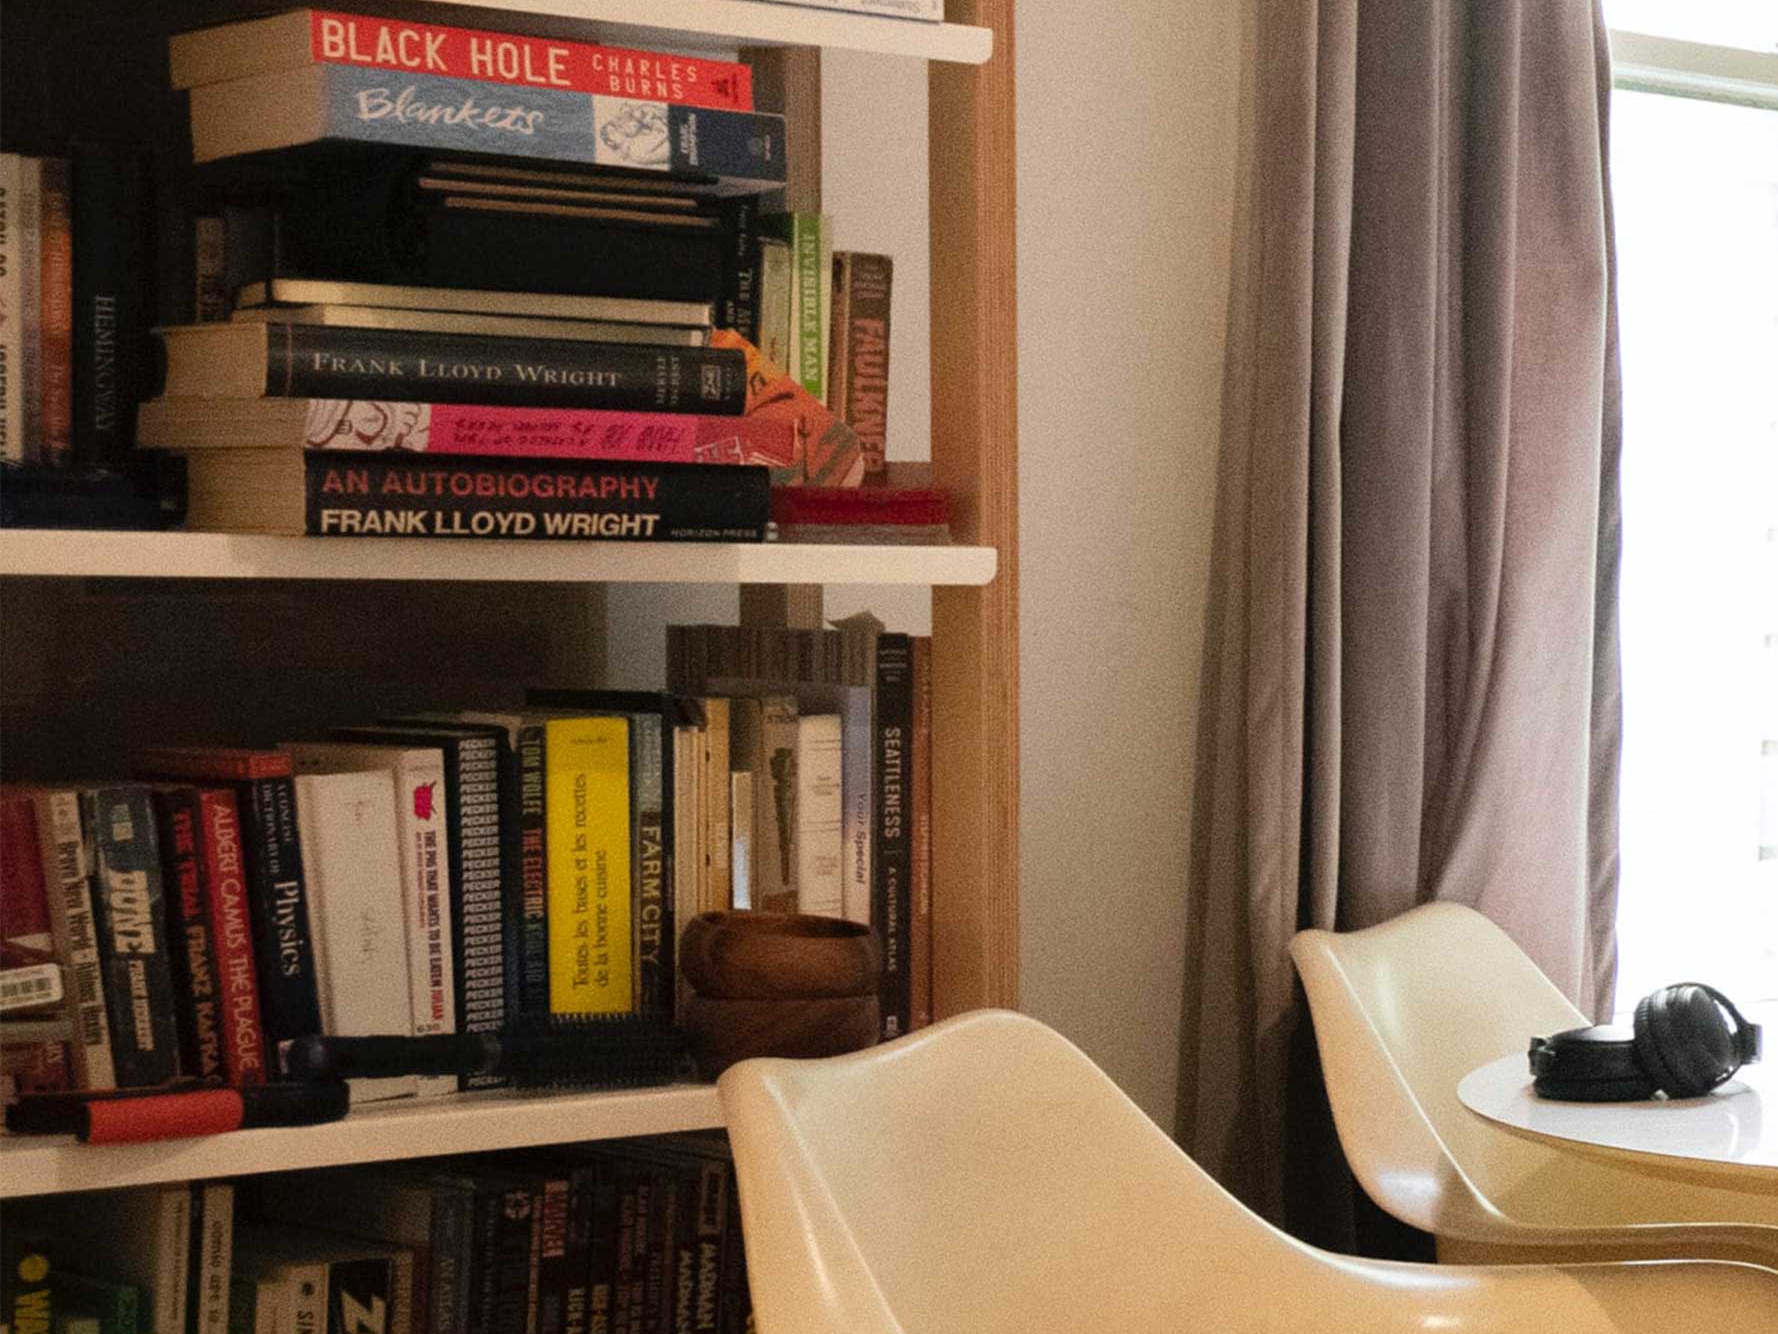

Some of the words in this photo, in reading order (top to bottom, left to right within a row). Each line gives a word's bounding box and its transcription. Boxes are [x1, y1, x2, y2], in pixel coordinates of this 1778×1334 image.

[322, 19, 448, 72] BLACK
[471, 38, 571, 86] HOLE
[591, 53, 698, 83] CHARLES
[357, 85, 545, 135] Blankets
[609, 75, 684, 101] BURNS
[801, 233, 817, 334] INVISIBLE
[94, 295, 116, 432] HEMINGWAY
[312, 352, 403, 375] FRANK
[418, 358, 514, 381] LLOYD
[515, 364, 621, 387] WRIGHT
[803, 337, 819, 381] MAN
[322, 469, 368, 495] AN
[382, 471, 660, 501] AUTOBIOGRAPHY
[320, 508, 427, 535] FRANK
[434, 509, 538, 535] LLOYD
[543, 512, 661, 537] WRIGHT
[521, 738, 542, 769] TOM
[521, 771, 542, 816] WOLFE
[572, 773, 587, 828] recettes
[884, 727, 902, 838] SEATTLENESS
[857, 792, 867, 827] Your
[213, 804, 239, 876] ALBERT
[426, 830, 437, 849] THE
[427, 850, 438, 868] PIG
[522, 826, 543, 853] THE
[571, 834, 587, 852] les
[641, 825, 662, 898] FARM
[854, 830, 867, 885] Special
[428, 870, 439, 892] THAT
[573, 857, 587, 872] et
[593, 849, 607, 899] cuisine
[522, 857, 543, 918] ELECTRIC
[572, 876, 588, 915] bases
[887, 877, 898, 933] CULTURAL
[110, 869, 156, 955] DUNE
[219, 878, 245, 949] CAMUS
[272, 880, 304, 978] Physics
[428, 893, 440, 928] WANTS
[572, 920, 588, 939] les
[593, 904, 608, 949] bonne
[429, 929, 440, 942] TO
[430, 943, 441, 957] BE
[640, 903, 663, 966] CITY
[887, 936, 898, 973] ATLAS
[187, 924, 213, 996] FRANZ
[230, 955, 248, 992] THE
[430, 957, 442, 987] EATEN
[572, 941, 590, 990] Toutes
[594, 952, 608, 966] la
[594, 970, 609, 988] de
[196, 999, 220, 1076] KAFKA
[235, 996, 260, 1073] PLAGUE
[697, 1242, 717, 1330] MADMAN
